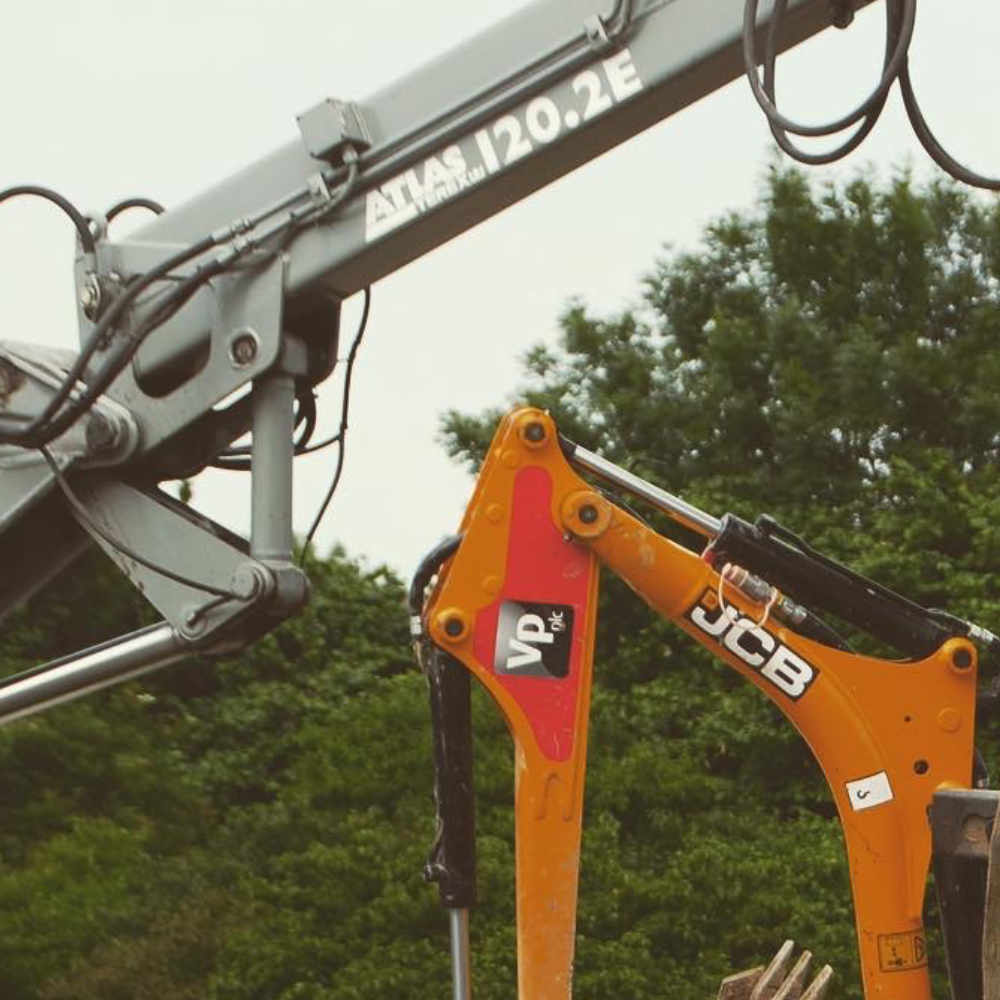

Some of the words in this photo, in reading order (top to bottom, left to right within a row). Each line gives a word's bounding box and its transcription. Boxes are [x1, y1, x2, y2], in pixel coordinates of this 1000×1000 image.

[365, 144, 467, 236] ATLAS
[475, 48, 643, 174] 120.2E
[691, 604, 815, 698] JCB
